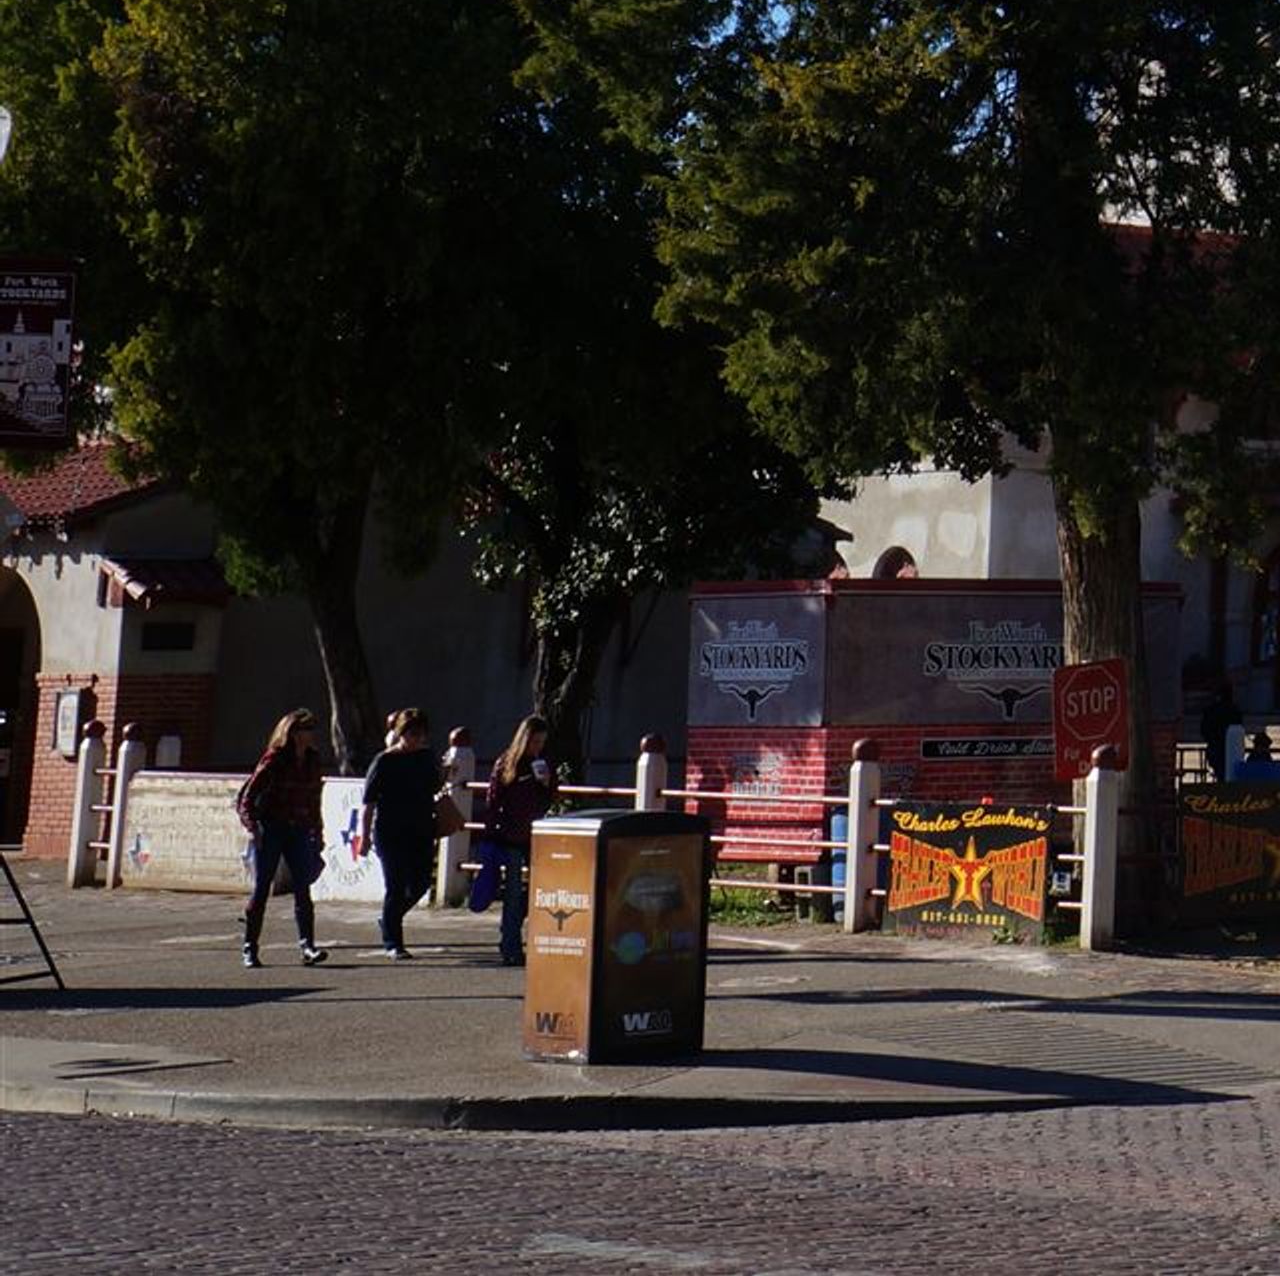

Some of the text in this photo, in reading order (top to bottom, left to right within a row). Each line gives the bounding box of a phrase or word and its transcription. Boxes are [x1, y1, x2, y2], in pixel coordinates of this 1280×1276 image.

[701, 642, 808, 675] STOCKYARDS
[925, 643, 1065, 675] STOCKYAR
[1067, 684, 1116, 718] STOP
[892, 806, 1049, 833] Charles Lawhon's
